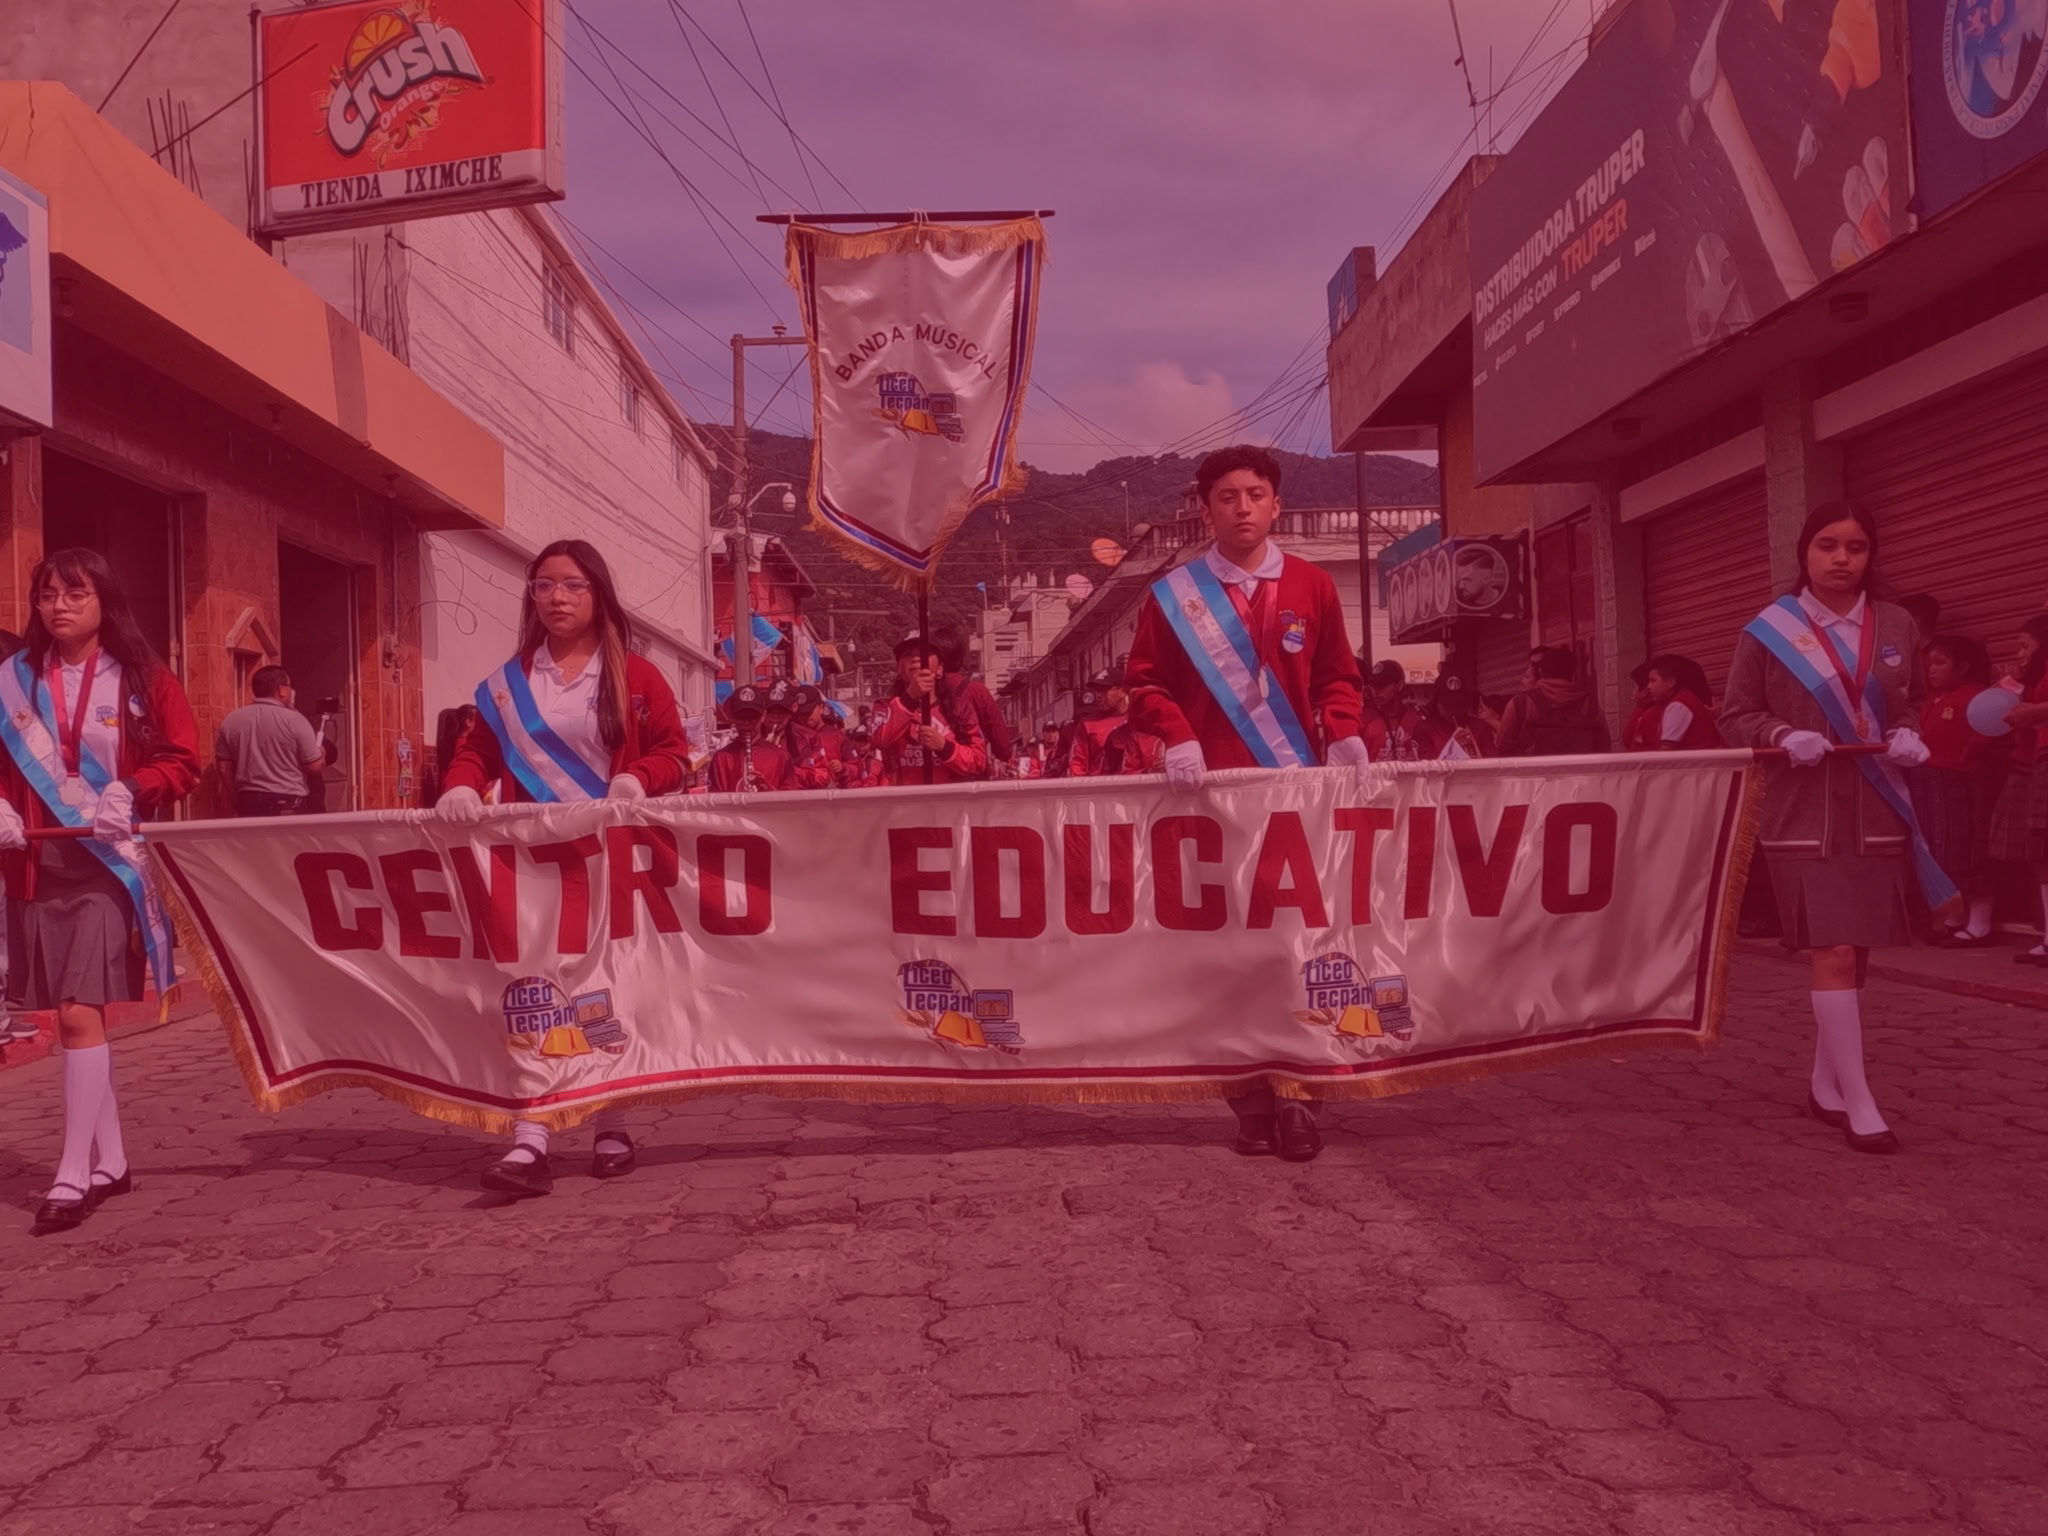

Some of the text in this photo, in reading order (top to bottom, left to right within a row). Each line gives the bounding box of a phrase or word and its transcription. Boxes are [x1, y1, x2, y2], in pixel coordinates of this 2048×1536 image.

[328, 21, 485, 152] Crush
[379, 79, 442, 131] orange
[301, 155, 502, 209] TIENDA IXIMCHE
[1475, 128, 1646, 325] DISTRIBUIDORA TRUPER
[1534, 265, 1557, 304] CON
[1561, 198, 1629, 282] TRUPER
[835, 323, 997, 382] BANDA MUSICAL
[295, 802, 1618, 963] CENTRO EDUCATIVO
[1305, 960, 1353, 988] Liceo
